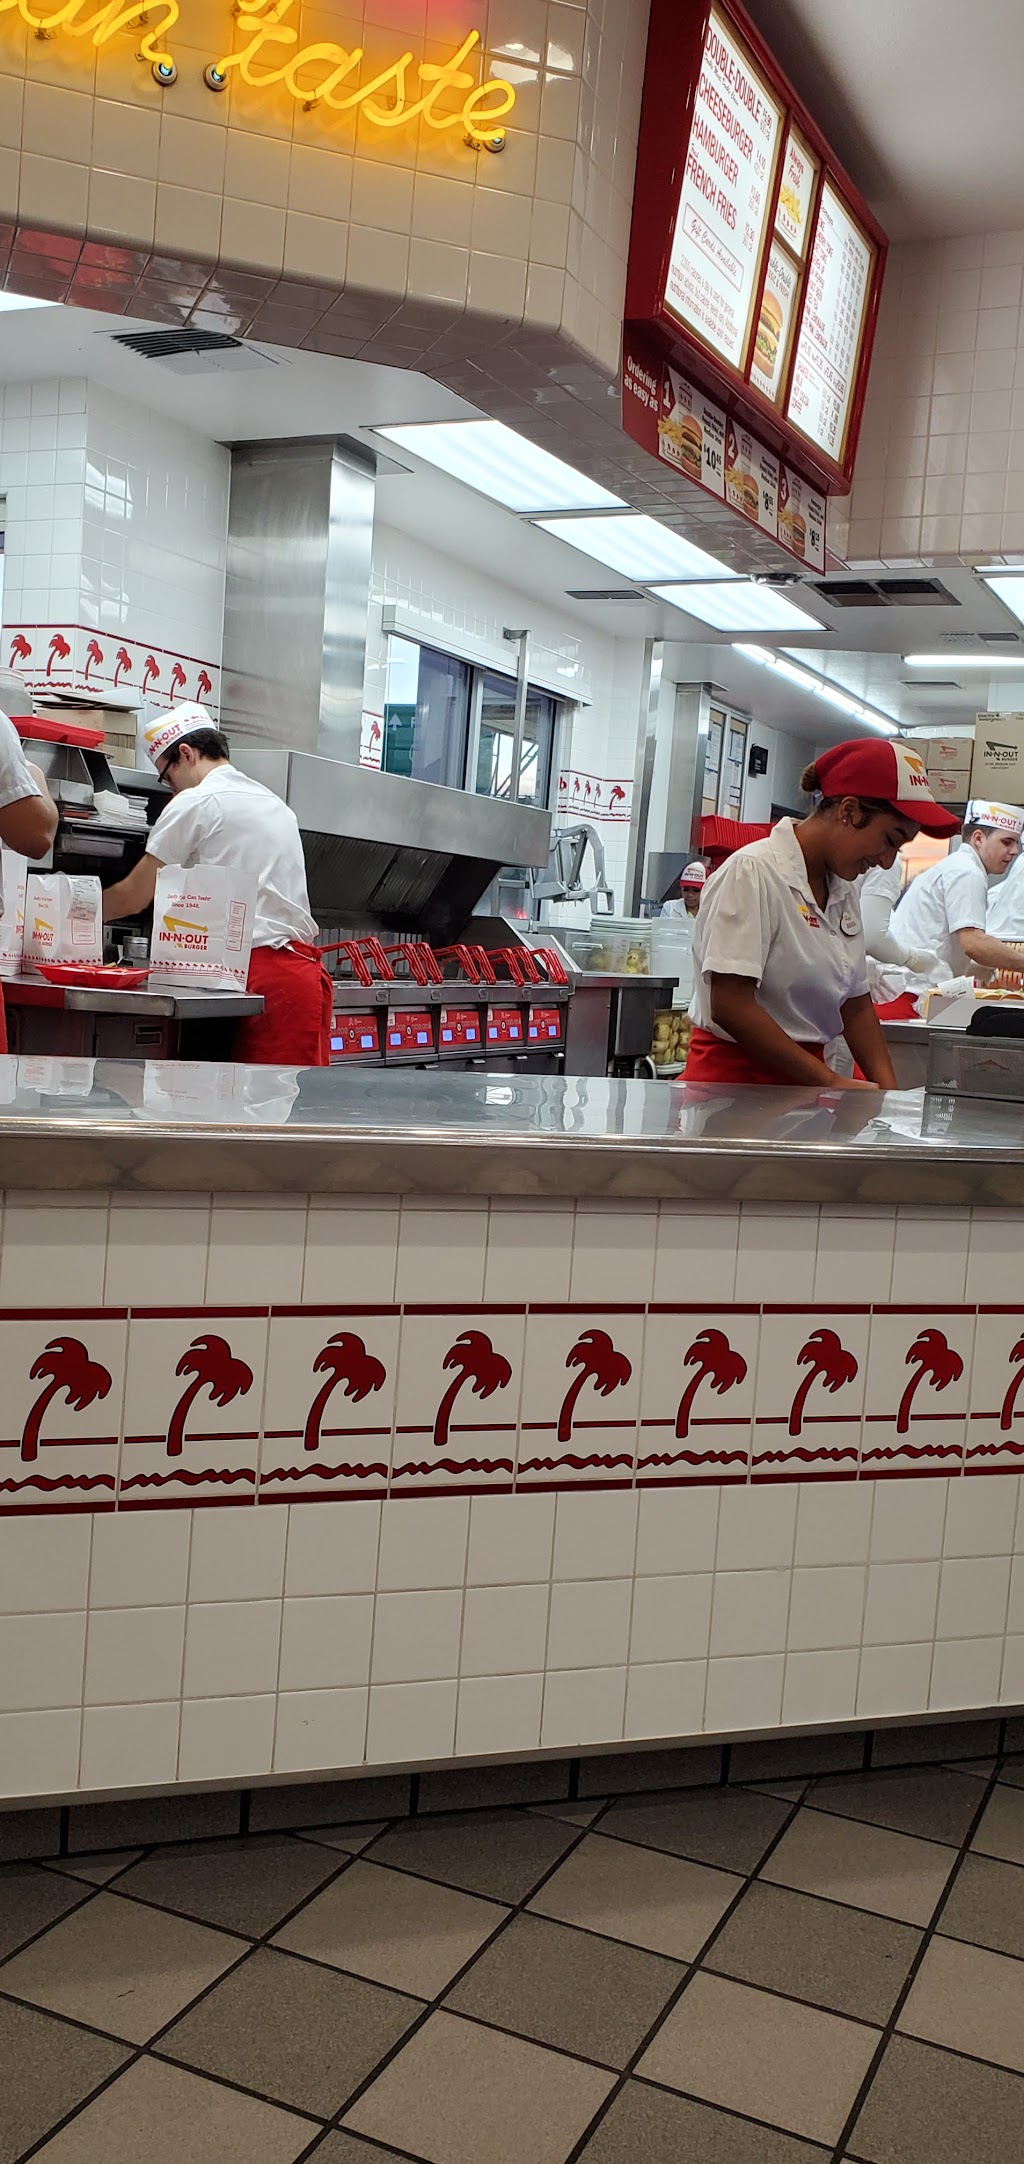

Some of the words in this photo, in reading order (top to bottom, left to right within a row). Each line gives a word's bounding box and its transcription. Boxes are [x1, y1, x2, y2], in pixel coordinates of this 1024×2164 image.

[216, 0, 516, 140] taste
[705, 27, 761, 122] DOUBLE-DOUBLE
[698, 73, 752, 159] CHEESEBURGER
[692, 112, 738, 185] HAMBURGER
[685, 153, 716, 205] FRENCH
[715, 190, 736, 229] FRIES
[690, 218, 701, 237] Gift
[701, 230, 715, 252] Cards
[715, 248, 736, 276] Available
[624, 374, 633, 391] as
[633, 381, 649, 407] easy
[649, 397, 658, 411] as
[627, 355, 657, 395] Ordering
[663, 381, 671, 409] 1
[728, 433, 735, 459] 2
[780, 479, 786, 500] 3
[981, 813, 1017, 826] IN-N-OUT
[32, 931, 54, 941] IN-N-OUT
[159, 931, 209, 944] IN-N-OUT
